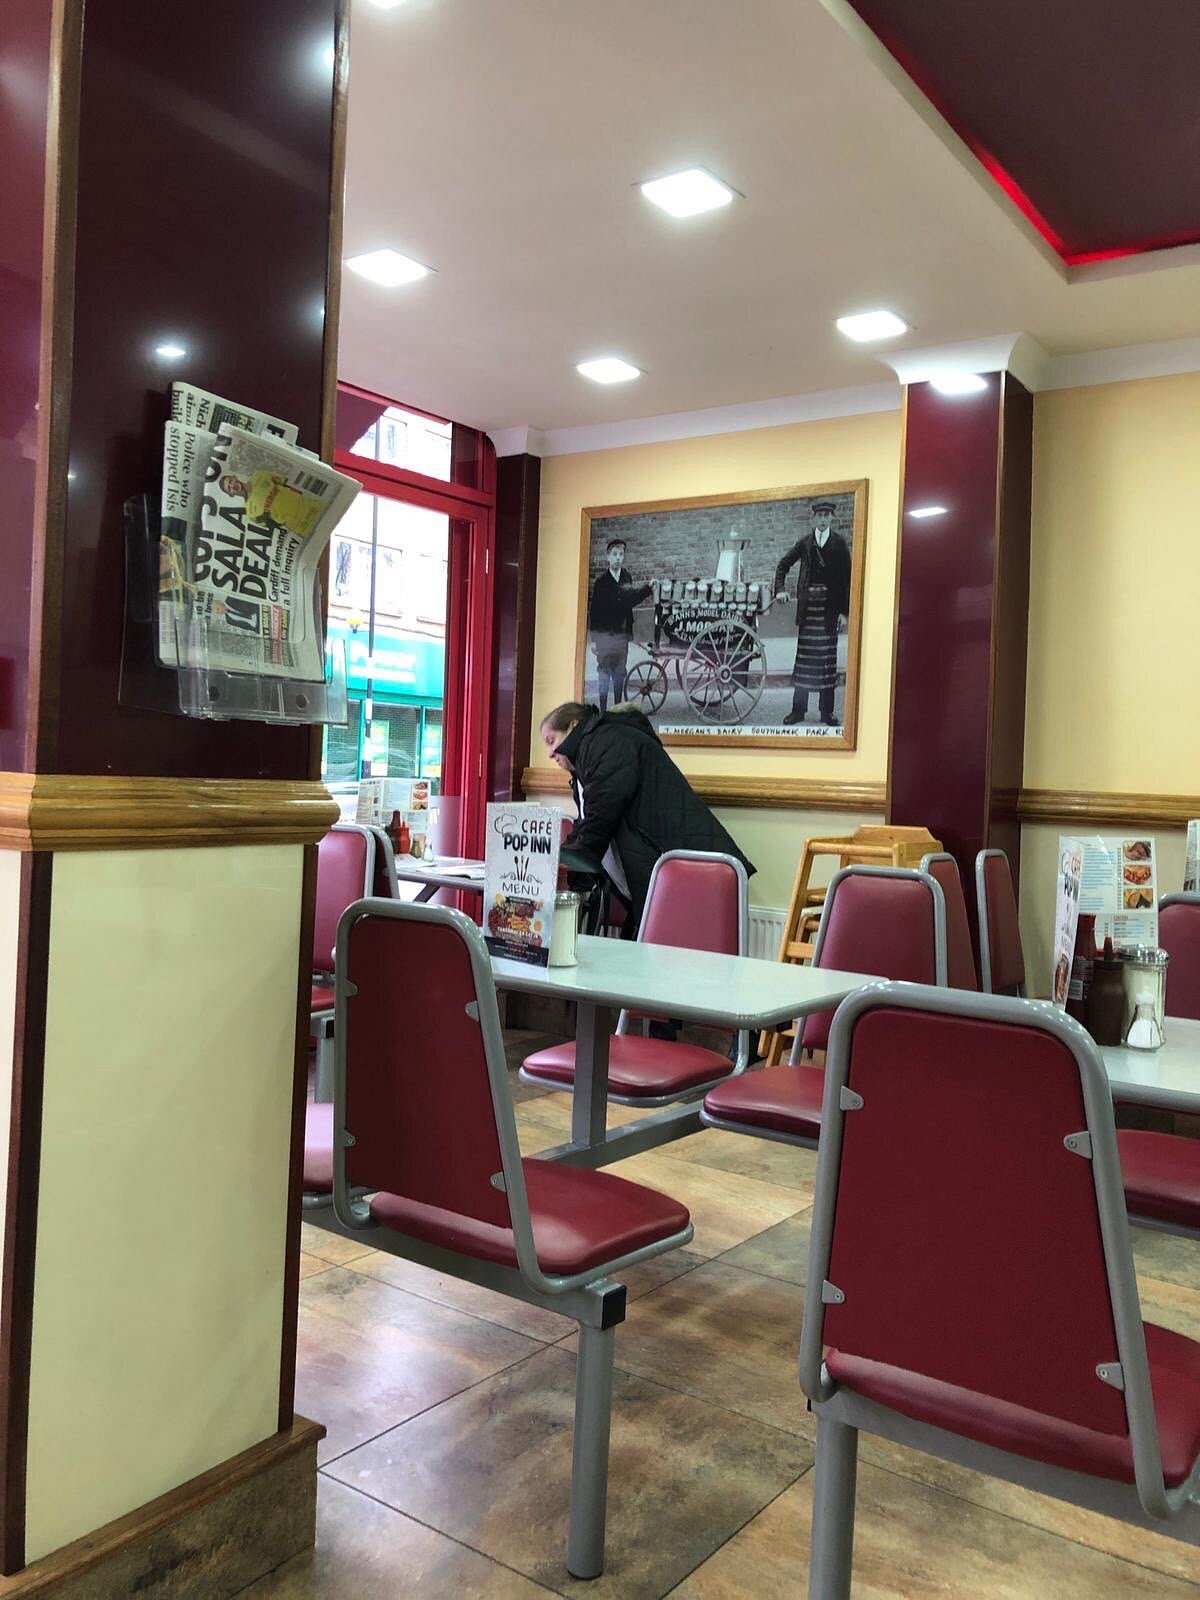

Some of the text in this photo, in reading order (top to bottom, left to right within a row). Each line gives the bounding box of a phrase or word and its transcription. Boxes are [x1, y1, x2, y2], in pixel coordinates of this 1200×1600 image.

[166, 427, 180, 512] stopped Isis
[179, 432, 196, 509] Police who
[211, 506, 246, 593] SALA
[239, 523, 276, 600] DEAL
[272, 527, 288, 567] demand
[283, 537, 301, 577] inquiry
[268, 566, 283, 603] Cardiff
[281, 575, 292, 596] full
[697, 607, 719, 617] MODEL
[717, 727, 743, 736] DAIRY
[751, 727, 799, 737] SOUTHWARK
[805, 727, 829, 737] PARK
[503, 833, 551, 855] POP INN
[521, 817, 552, 836] CAFÉ
[502, 881, 541, 897] MENU
